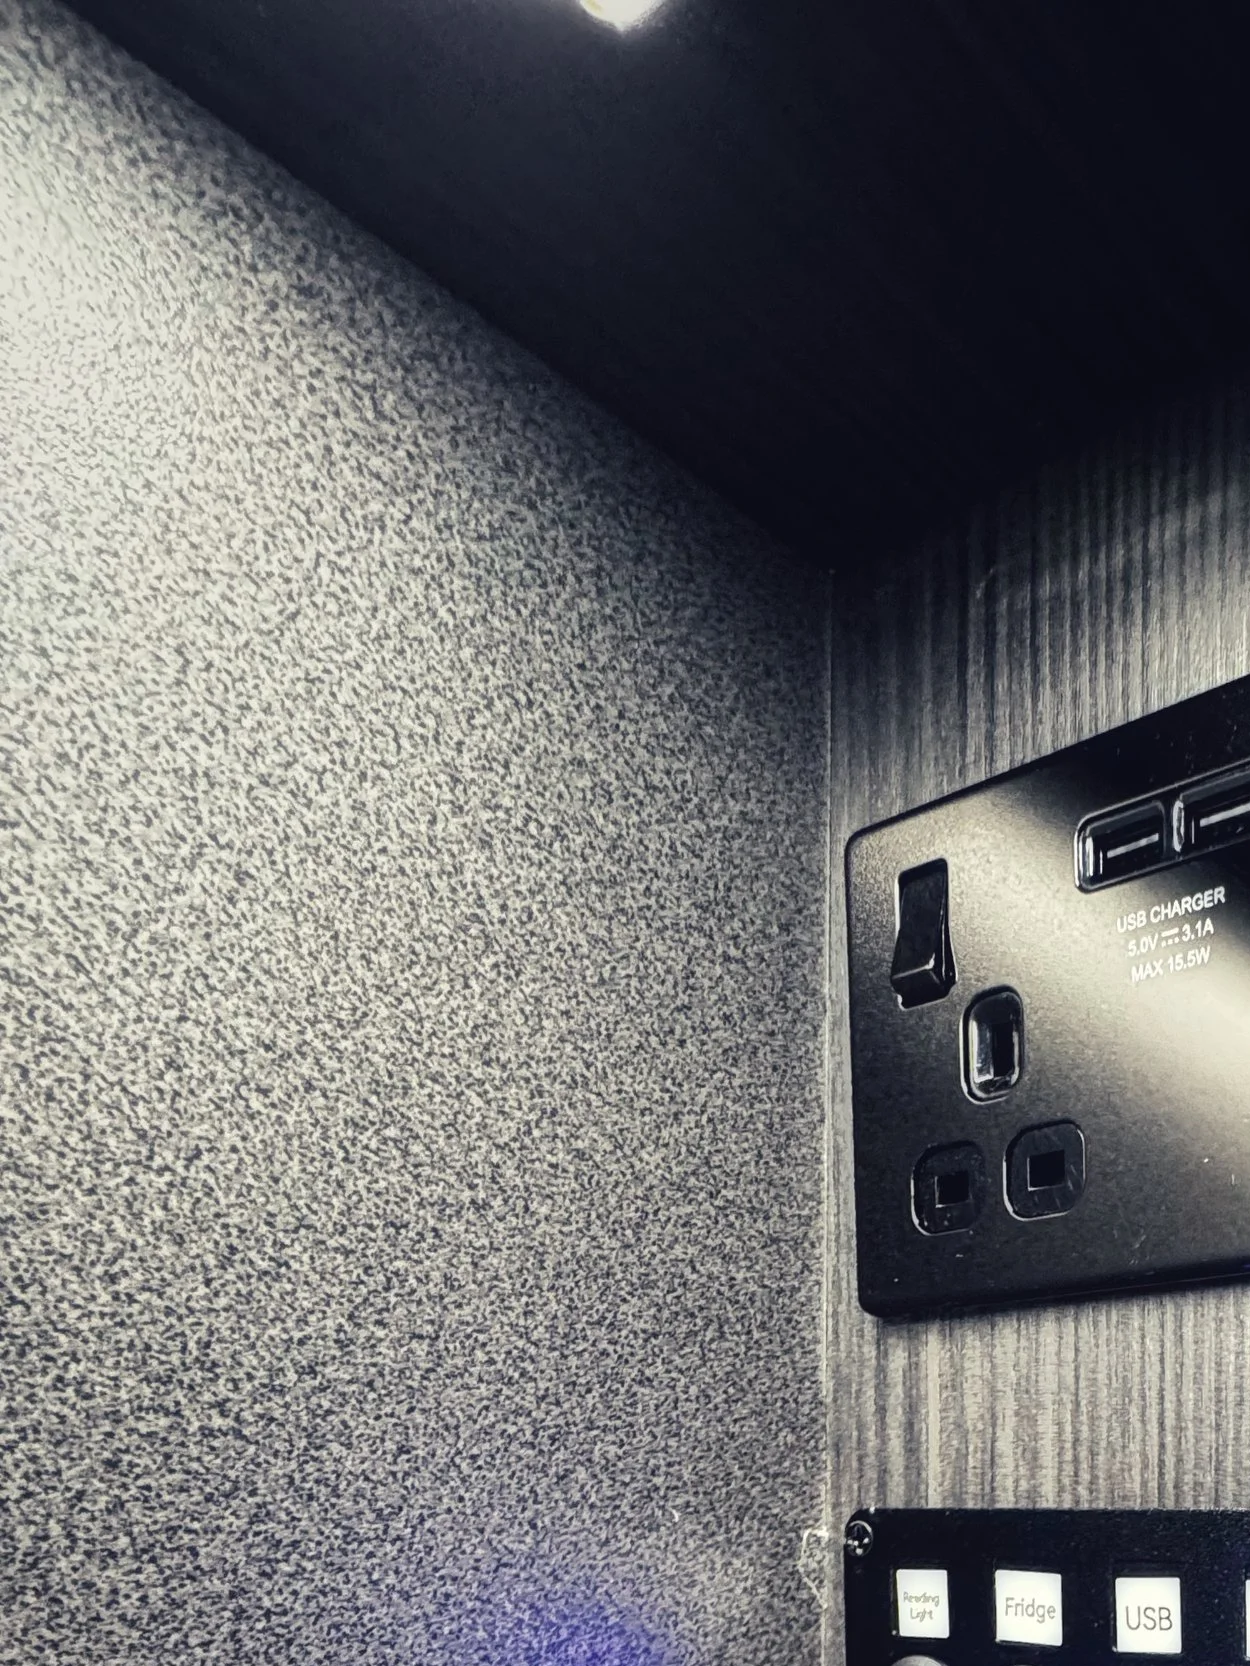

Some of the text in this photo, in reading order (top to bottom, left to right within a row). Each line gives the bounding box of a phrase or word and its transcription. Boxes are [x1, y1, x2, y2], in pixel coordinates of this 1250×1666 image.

[1116, 885, 1226, 933] USB CHARGER
[1127, 917, 1214, 959] 5.0V 3.1A
[1131, 945, 1211, 982] MAX 15.5W
[1005, 1596, 1056, 1624] Fridge
[1125, 1605, 1173, 1631] USB
